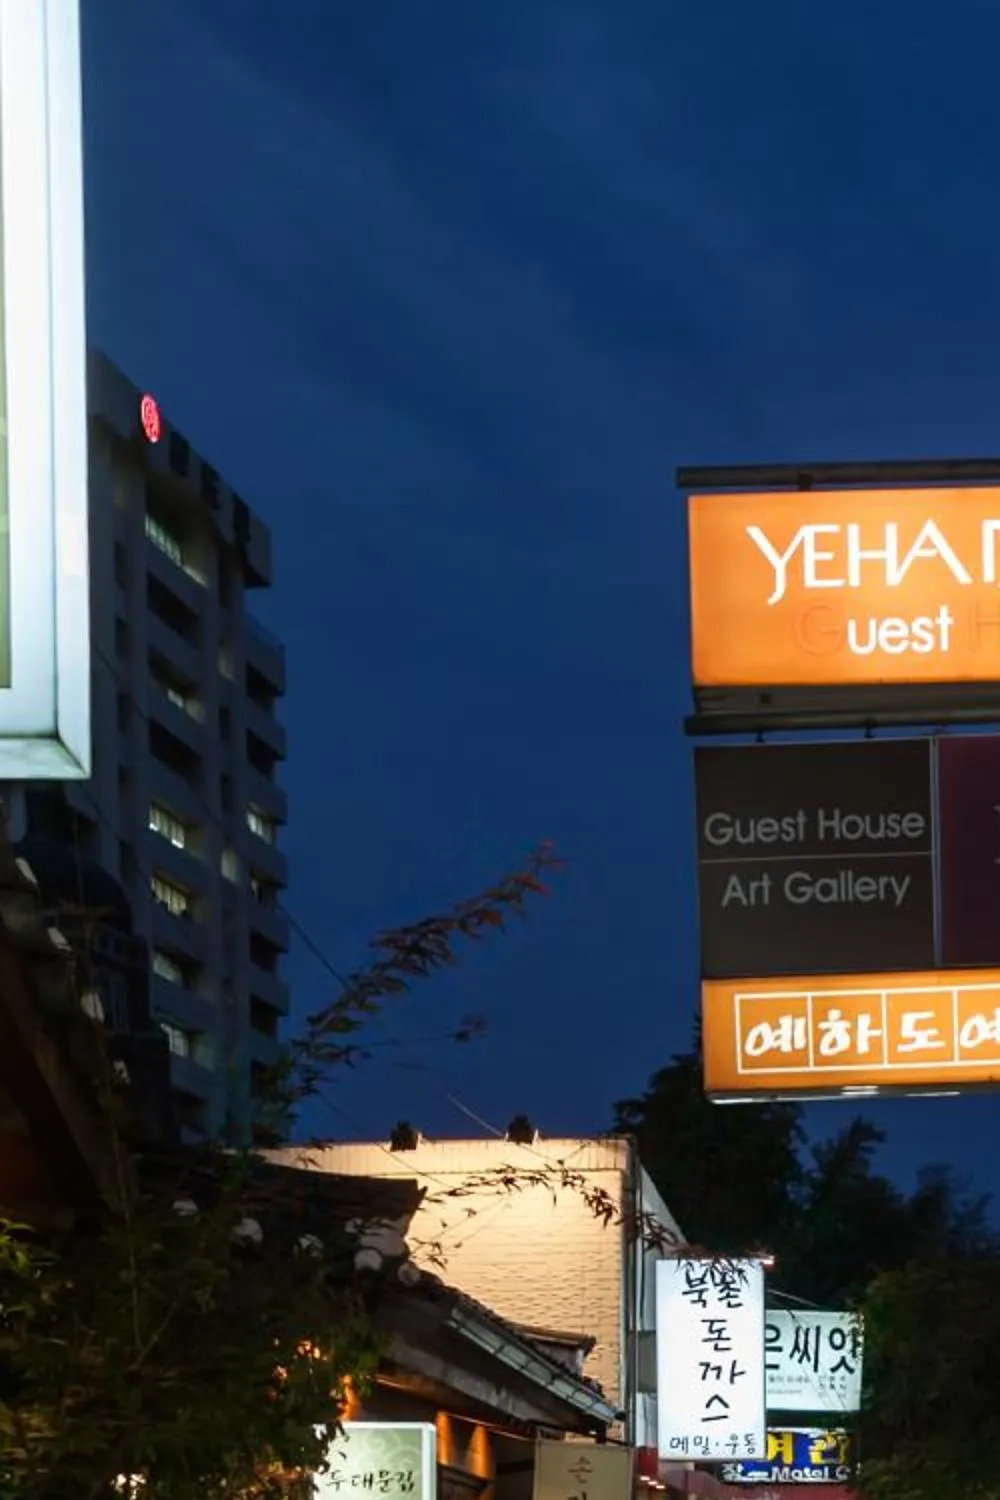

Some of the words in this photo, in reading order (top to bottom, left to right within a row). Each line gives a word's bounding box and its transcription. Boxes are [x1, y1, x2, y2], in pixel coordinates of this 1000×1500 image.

[746, 518, 973, 605] YEHA
[704, 809, 807, 846] Guest
[818, 807, 926, 841] House
[721, 872, 772, 908] Art
[783, 869, 912, 908] Gallery
[770, 1465, 830, 1481] Motel
